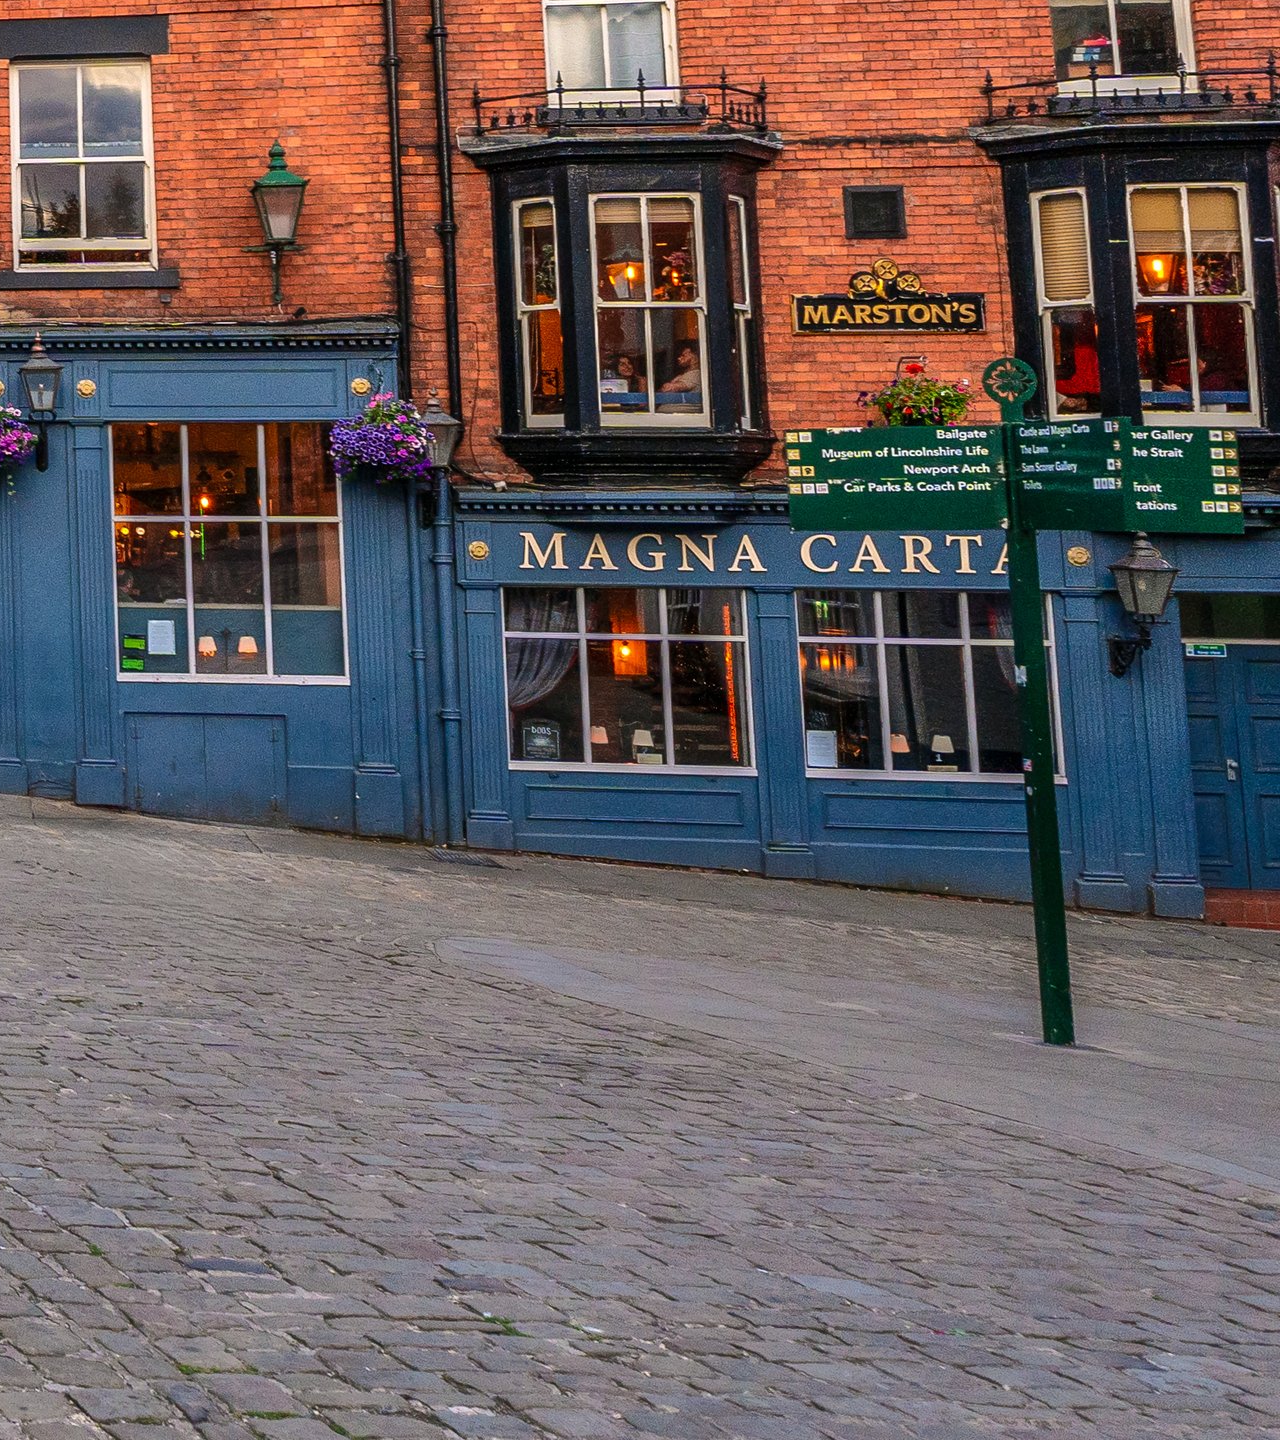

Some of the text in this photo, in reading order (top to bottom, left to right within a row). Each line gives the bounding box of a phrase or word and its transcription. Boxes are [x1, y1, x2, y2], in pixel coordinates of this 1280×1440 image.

[802, 302, 977, 324] MARSTON'S
[936, 429, 988, 440] Bailgate
[1019, 424, 1090, 437] Castle and Magna Carta
[1150, 430, 1194, 442] Gallery
[821, 446, 989, 458] Museum of Lincolnshire Life
[1019, 444, 1032, 454] The
[1150, 447, 1184, 458] Strait
[903, 464, 991, 476] Newport Arch
[1021, 462, 1035, 472] Sam
[1055, 460, 1078, 473] Gallery
[843, 483, 865, 493] Car
[868, 482, 901, 493] Parks
[904, 482, 914, 492] &
[916, 481, 955, 492] Coach
[957, 481, 991, 491] Point
[1136, 500, 1178, 511] tations
[519, 532, 768, 573] MAGNA
